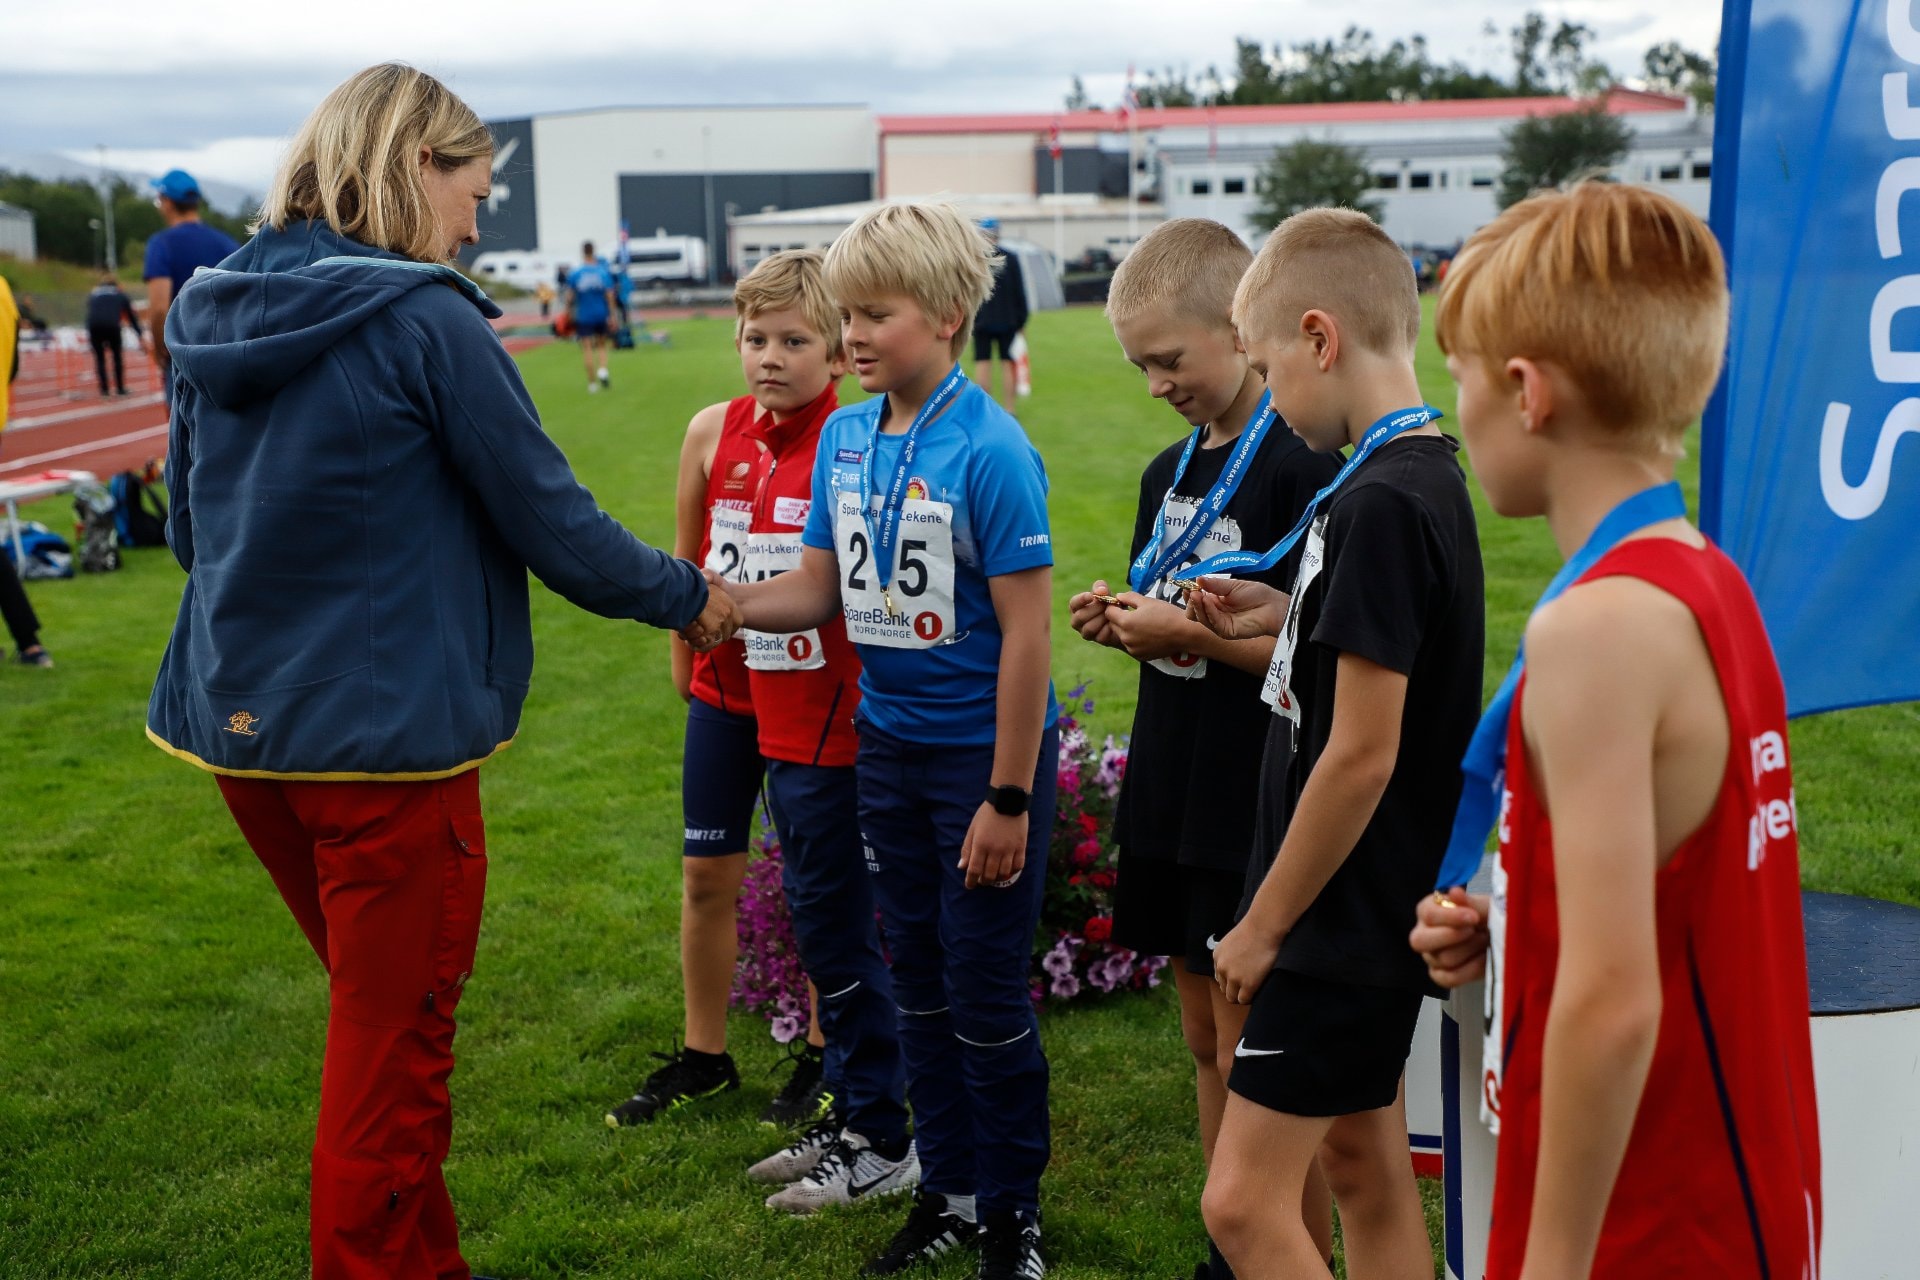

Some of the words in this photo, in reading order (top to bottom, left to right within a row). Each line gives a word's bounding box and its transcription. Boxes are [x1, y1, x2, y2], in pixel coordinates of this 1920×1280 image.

[1240, 441, 1251, 460] HOPP
[1233, 459, 1242, 470] OG
[1225, 468, 1237, 487] KAST
[882, 530, 890, 548] KAST
[1212, 557, 1228, 567] KAST
[844, 603, 910, 628] SpareBank
[854, 625, 911, 639] NORD-NORGE
